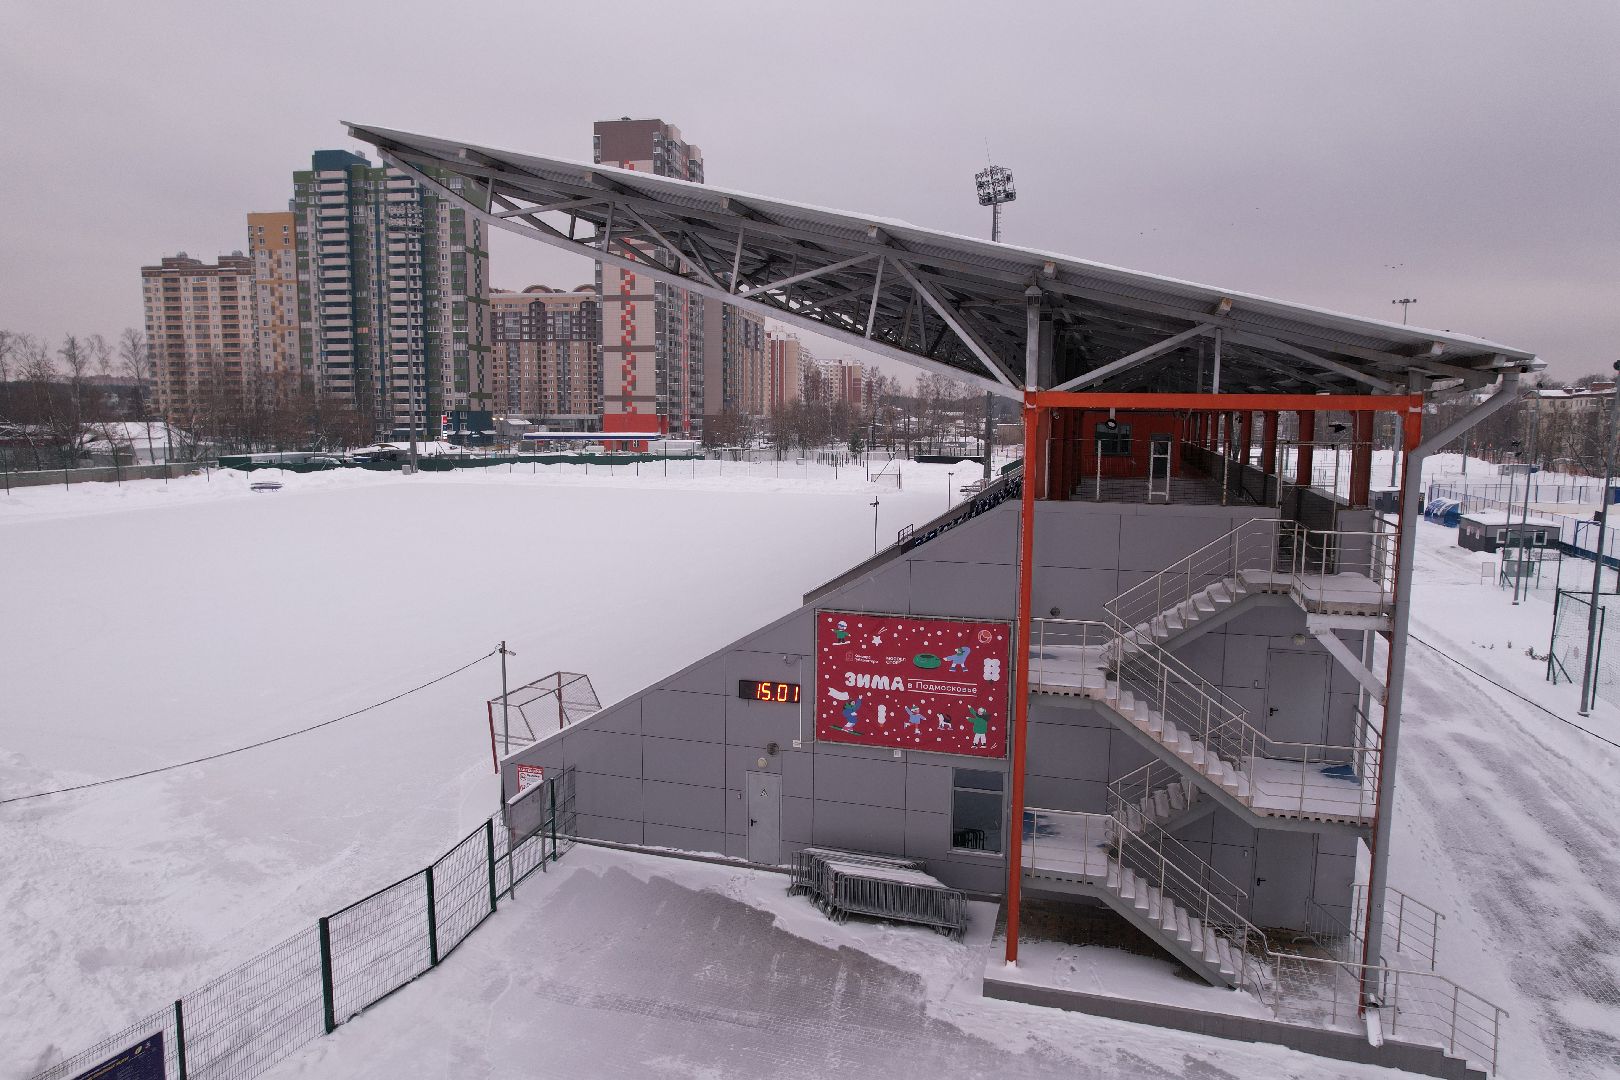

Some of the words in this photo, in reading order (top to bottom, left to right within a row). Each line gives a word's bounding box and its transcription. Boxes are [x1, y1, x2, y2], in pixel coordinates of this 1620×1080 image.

[757, 682, 799, 702] 15.01
[844, 671, 905, 692] ЗИМА
[916, 681, 978, 694] Подмосковье
